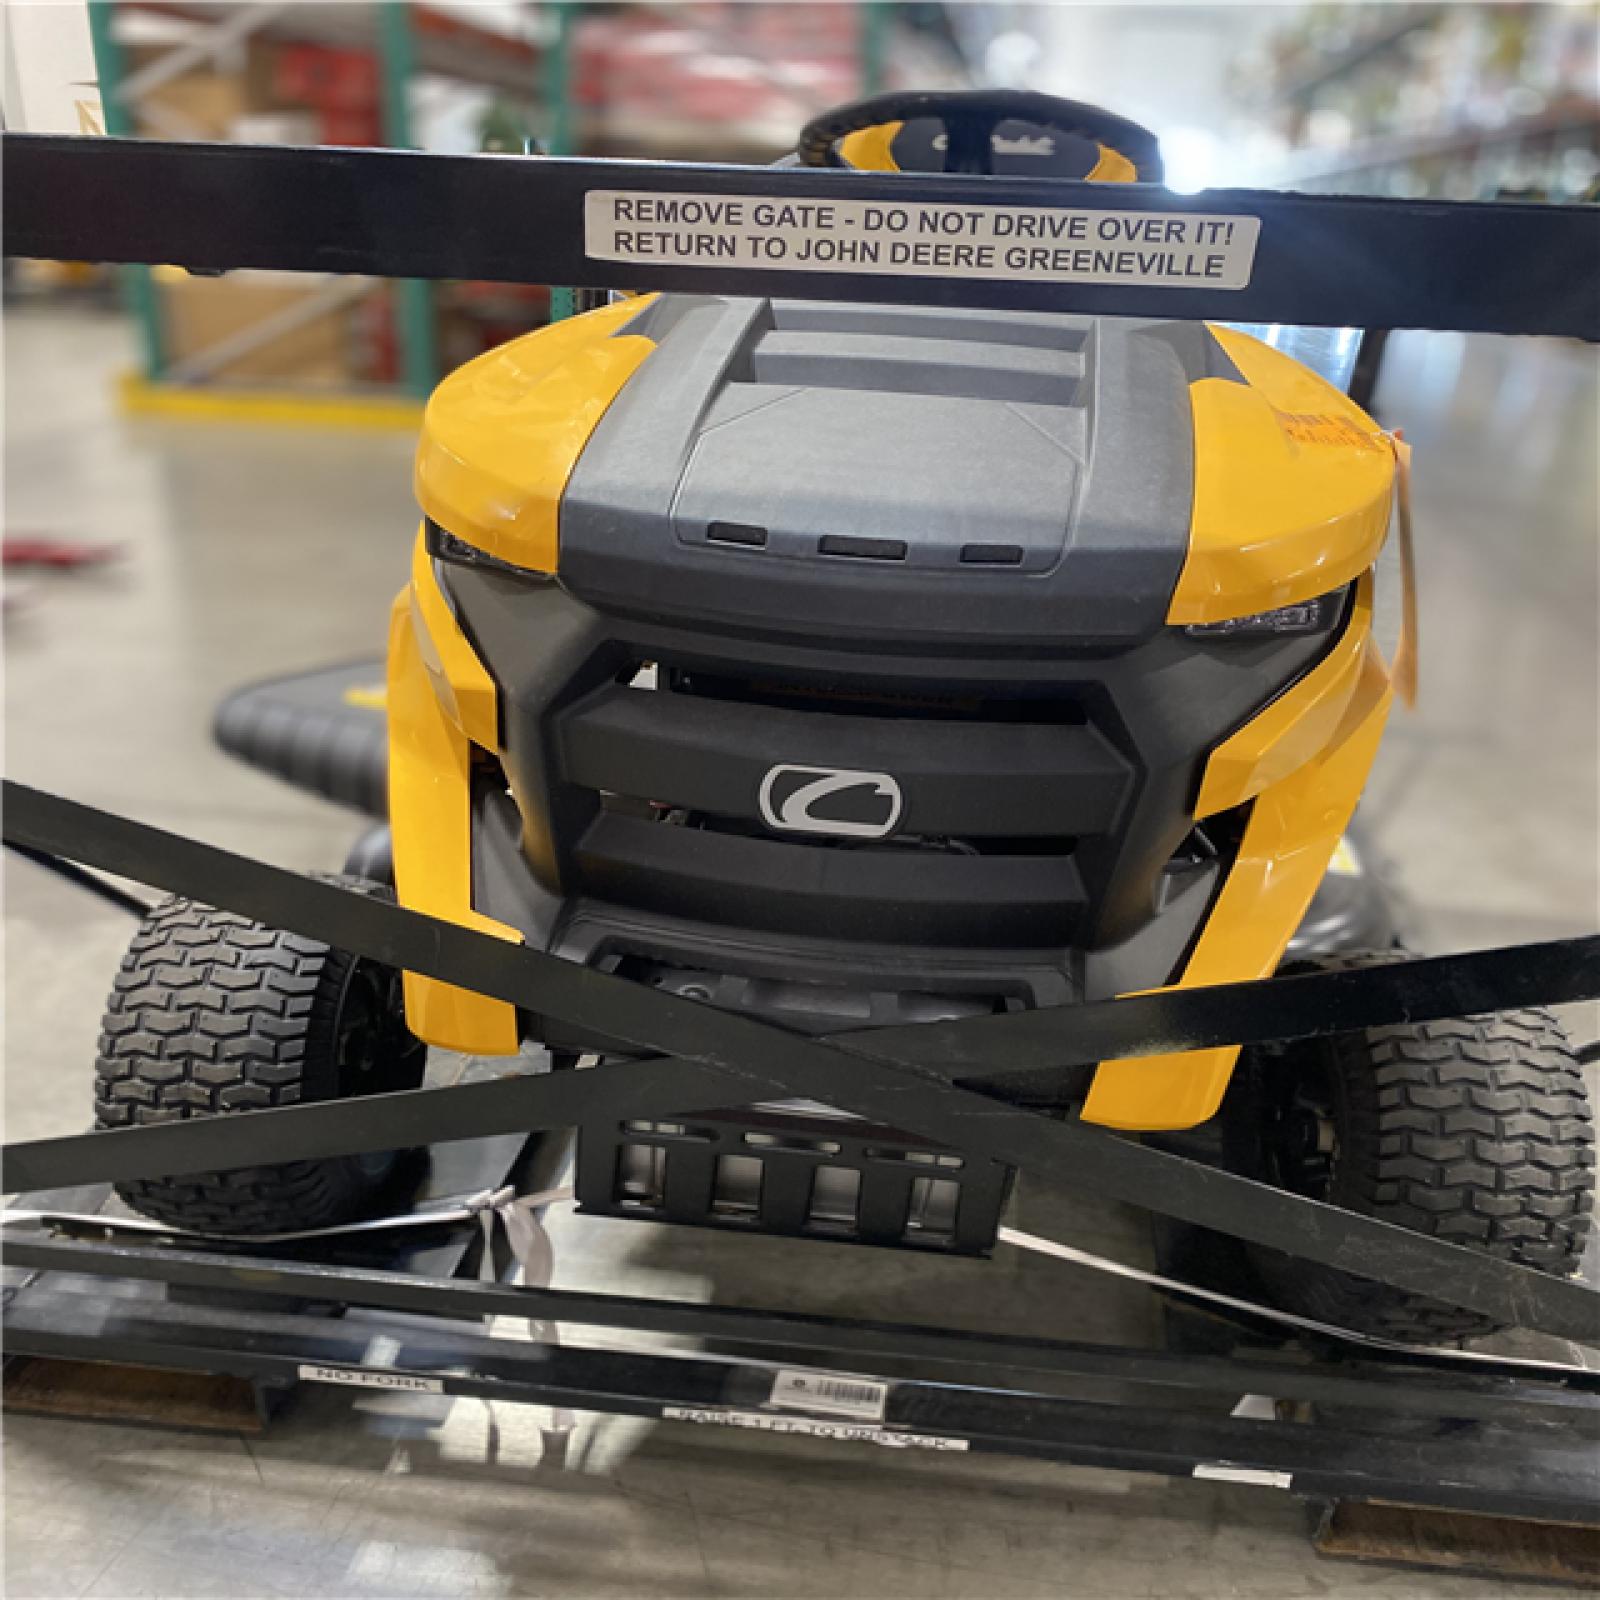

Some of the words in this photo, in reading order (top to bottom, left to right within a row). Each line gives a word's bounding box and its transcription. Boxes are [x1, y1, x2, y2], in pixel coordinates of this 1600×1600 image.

[613, 198, 743, 226] REMOVE
[754, 204, 836, 229] GATE
[864, 208, 909, 233] DO
[919, 210, 985, 236] NOT
[993, 214, 1088, 240] DRIVE
[1097, 217, 1186, 244] OVER
[1194, 221, 1234, 246] IT!
[613, 230, 736, 258] RETURN
[747, 236, 788, 259] TO
[796, 238, 881, 263] JOHN
[889, 242, 996, 268] DEERE
[1004, 247, 1226, 278] GREENEVILLE
[318, 1369, 353, 1381] NO
